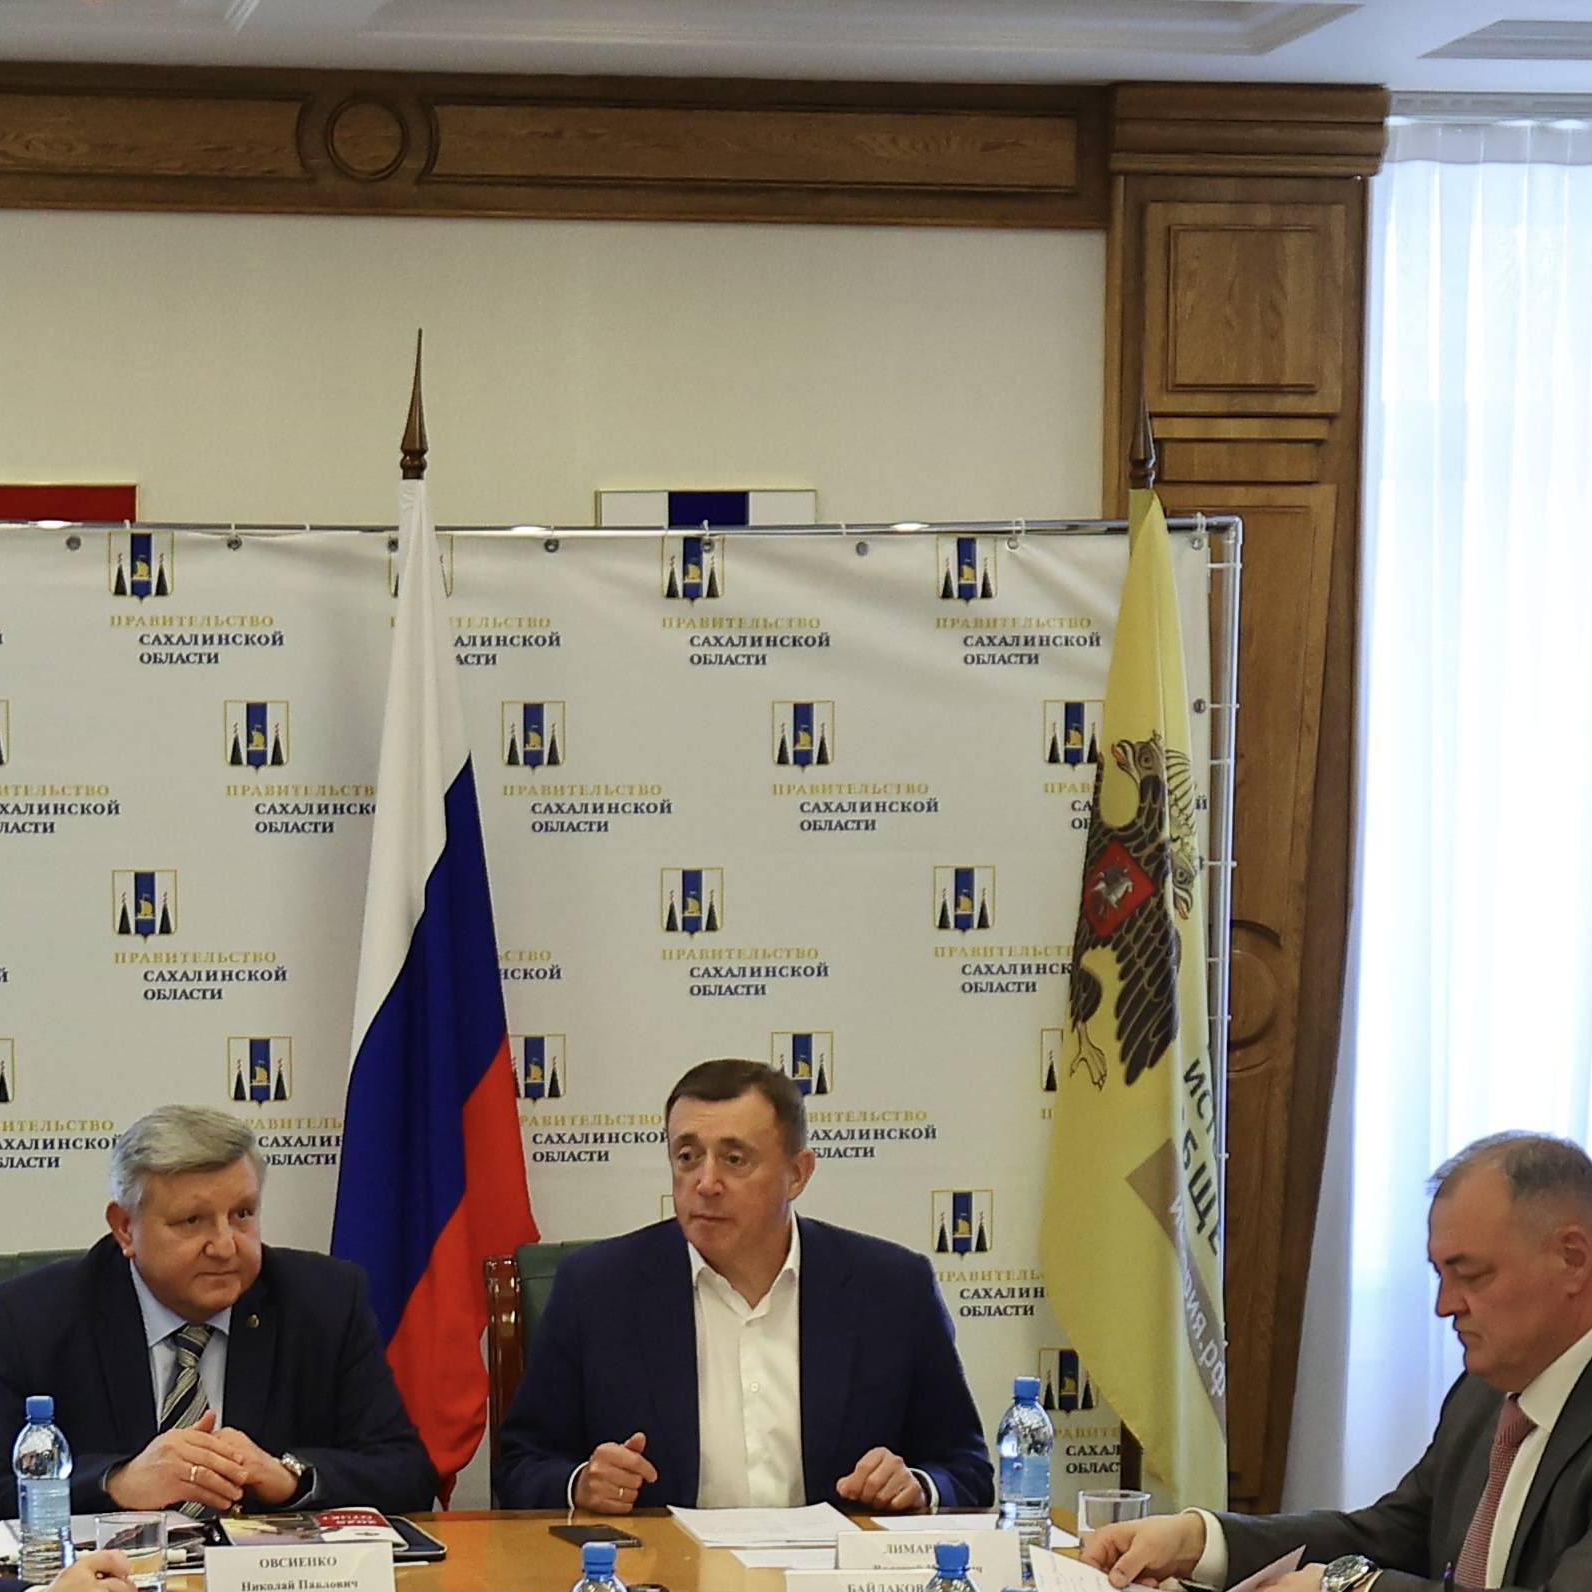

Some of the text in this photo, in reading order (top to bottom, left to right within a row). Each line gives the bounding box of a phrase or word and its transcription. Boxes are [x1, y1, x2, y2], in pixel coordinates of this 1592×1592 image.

[138, 631, 284, 647] САХАЛИНСКОЙ
[454, 631, 561, 647] АЛИНСКОЙ
[689, 632, 830, 648] САХАЛИНСКОЙ
[962, 631, 1101, 648] САХАЛИНСКОЙ
[139, 652, 219, 665] ОБЛАСТИ
[689, 653, 767, 666] ОБЛАСТИ
[963, 652, 1040, 665] ОБЛАСТИ
[226, 783, 376, 797] ПРАВИТЕЛЬСТВ
[530, 799, 672, 815] САХАЛИНСКОЙ
[799, 797, 939, 814] САХАЛИНСКОЙ
[255, 821, 335, 834] ОБЛАСТИ
[531, 820, 609, 833] ОБЛАСТИ
[799, 819, 876, 832] ОБЛАСТИ
[143, 965, 287, 983] САХАЛИНСКОЙ
[689, 962, 829, 979] САХАЛИНСКОЙ
[960, 963, 1072, 976] САХАЛИНСК
[143, 988, 223, 1001] ОБЛАСТИ
[689, 983, 767, 997] ОБЛАСТИ
[960, 982, 1037, 994] ОБЛАСТИ
[521, 1114, 663, 1127] РАВИТЕЛЬСТВО
[808, 1124, 938, 1141] АХАЛИНСКОЙ
[532, 1151, 610, 1163] ОБЛАСТИ
[959, 1286, 1046, 1300] САХАЛИН
[959, 1304, 1035, 1317] ОБЛАСТИ
[259, 1556, 337, 1568] ОВСИЕНКО
[241, 1579, 358, 1592] Николай Павлович
